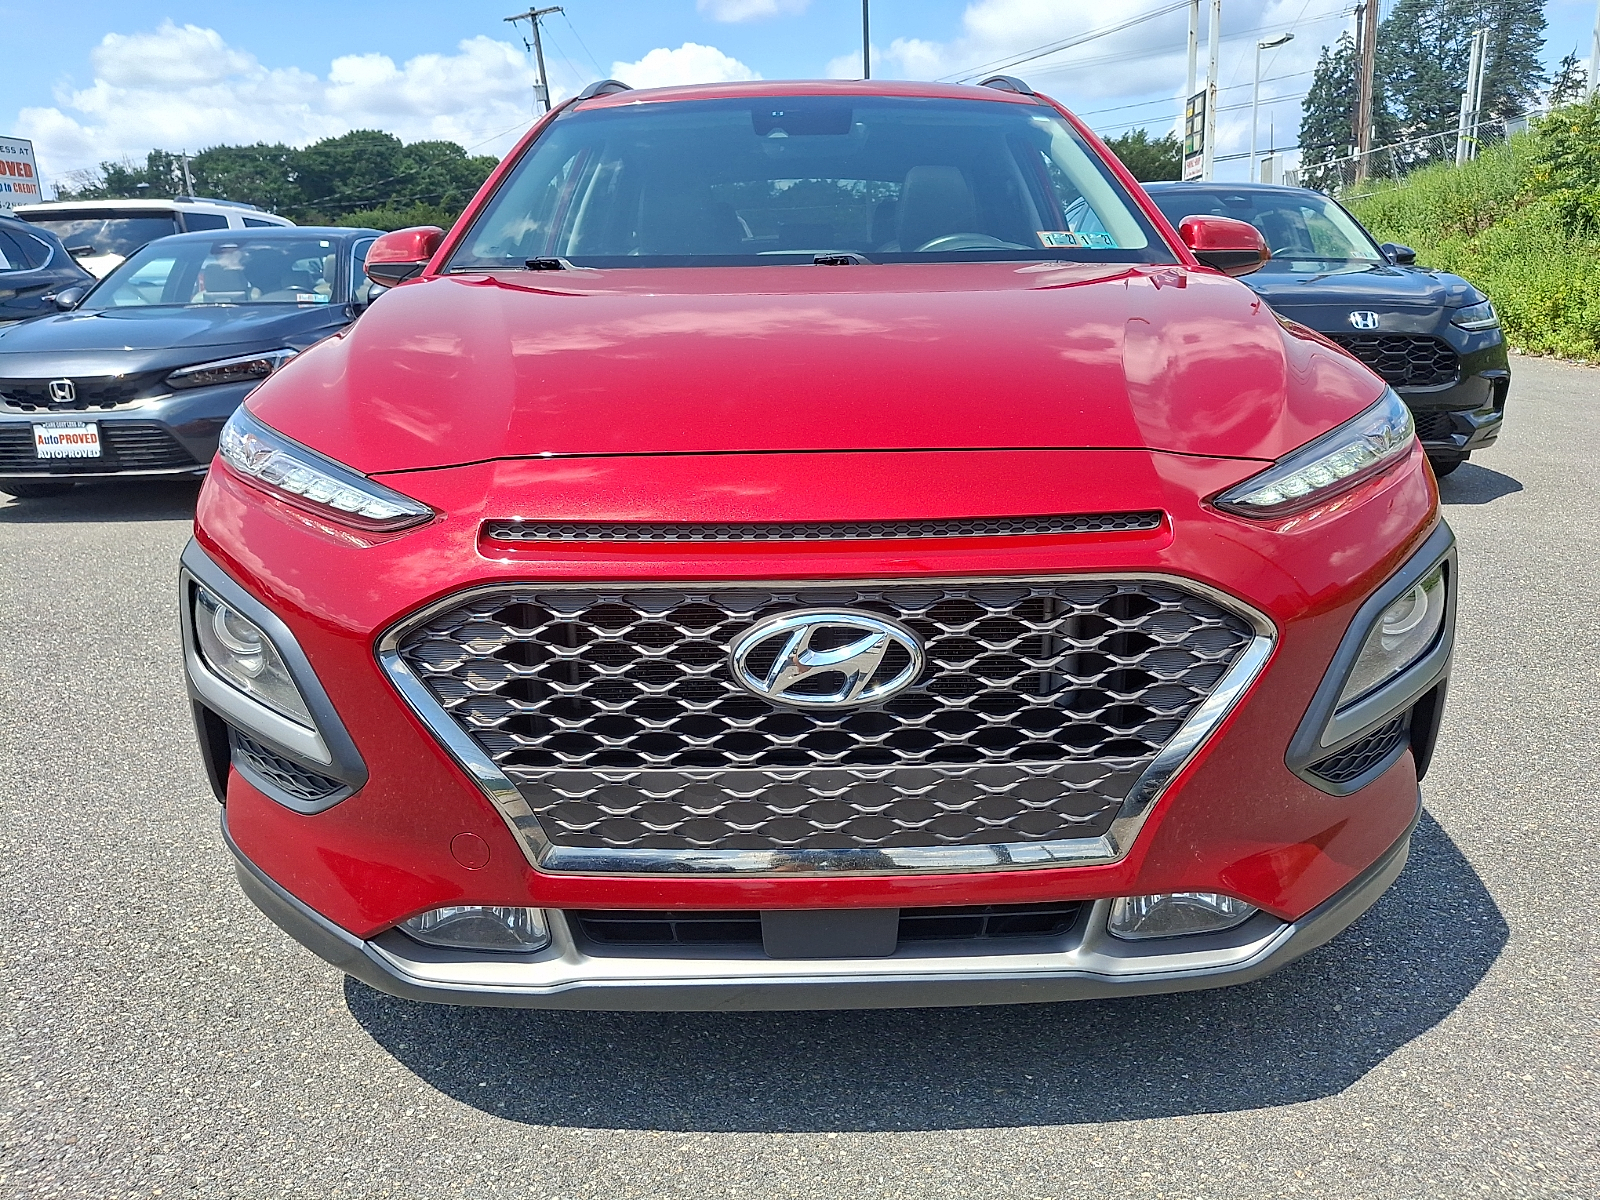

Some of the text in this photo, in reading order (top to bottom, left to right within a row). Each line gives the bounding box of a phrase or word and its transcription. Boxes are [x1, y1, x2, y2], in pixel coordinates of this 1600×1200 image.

[13, 182, 37, 194] CREDIT
[38, 433, 97, 445] AutoPROVED
[37, 449, 101, 459] AUTOPROVED
